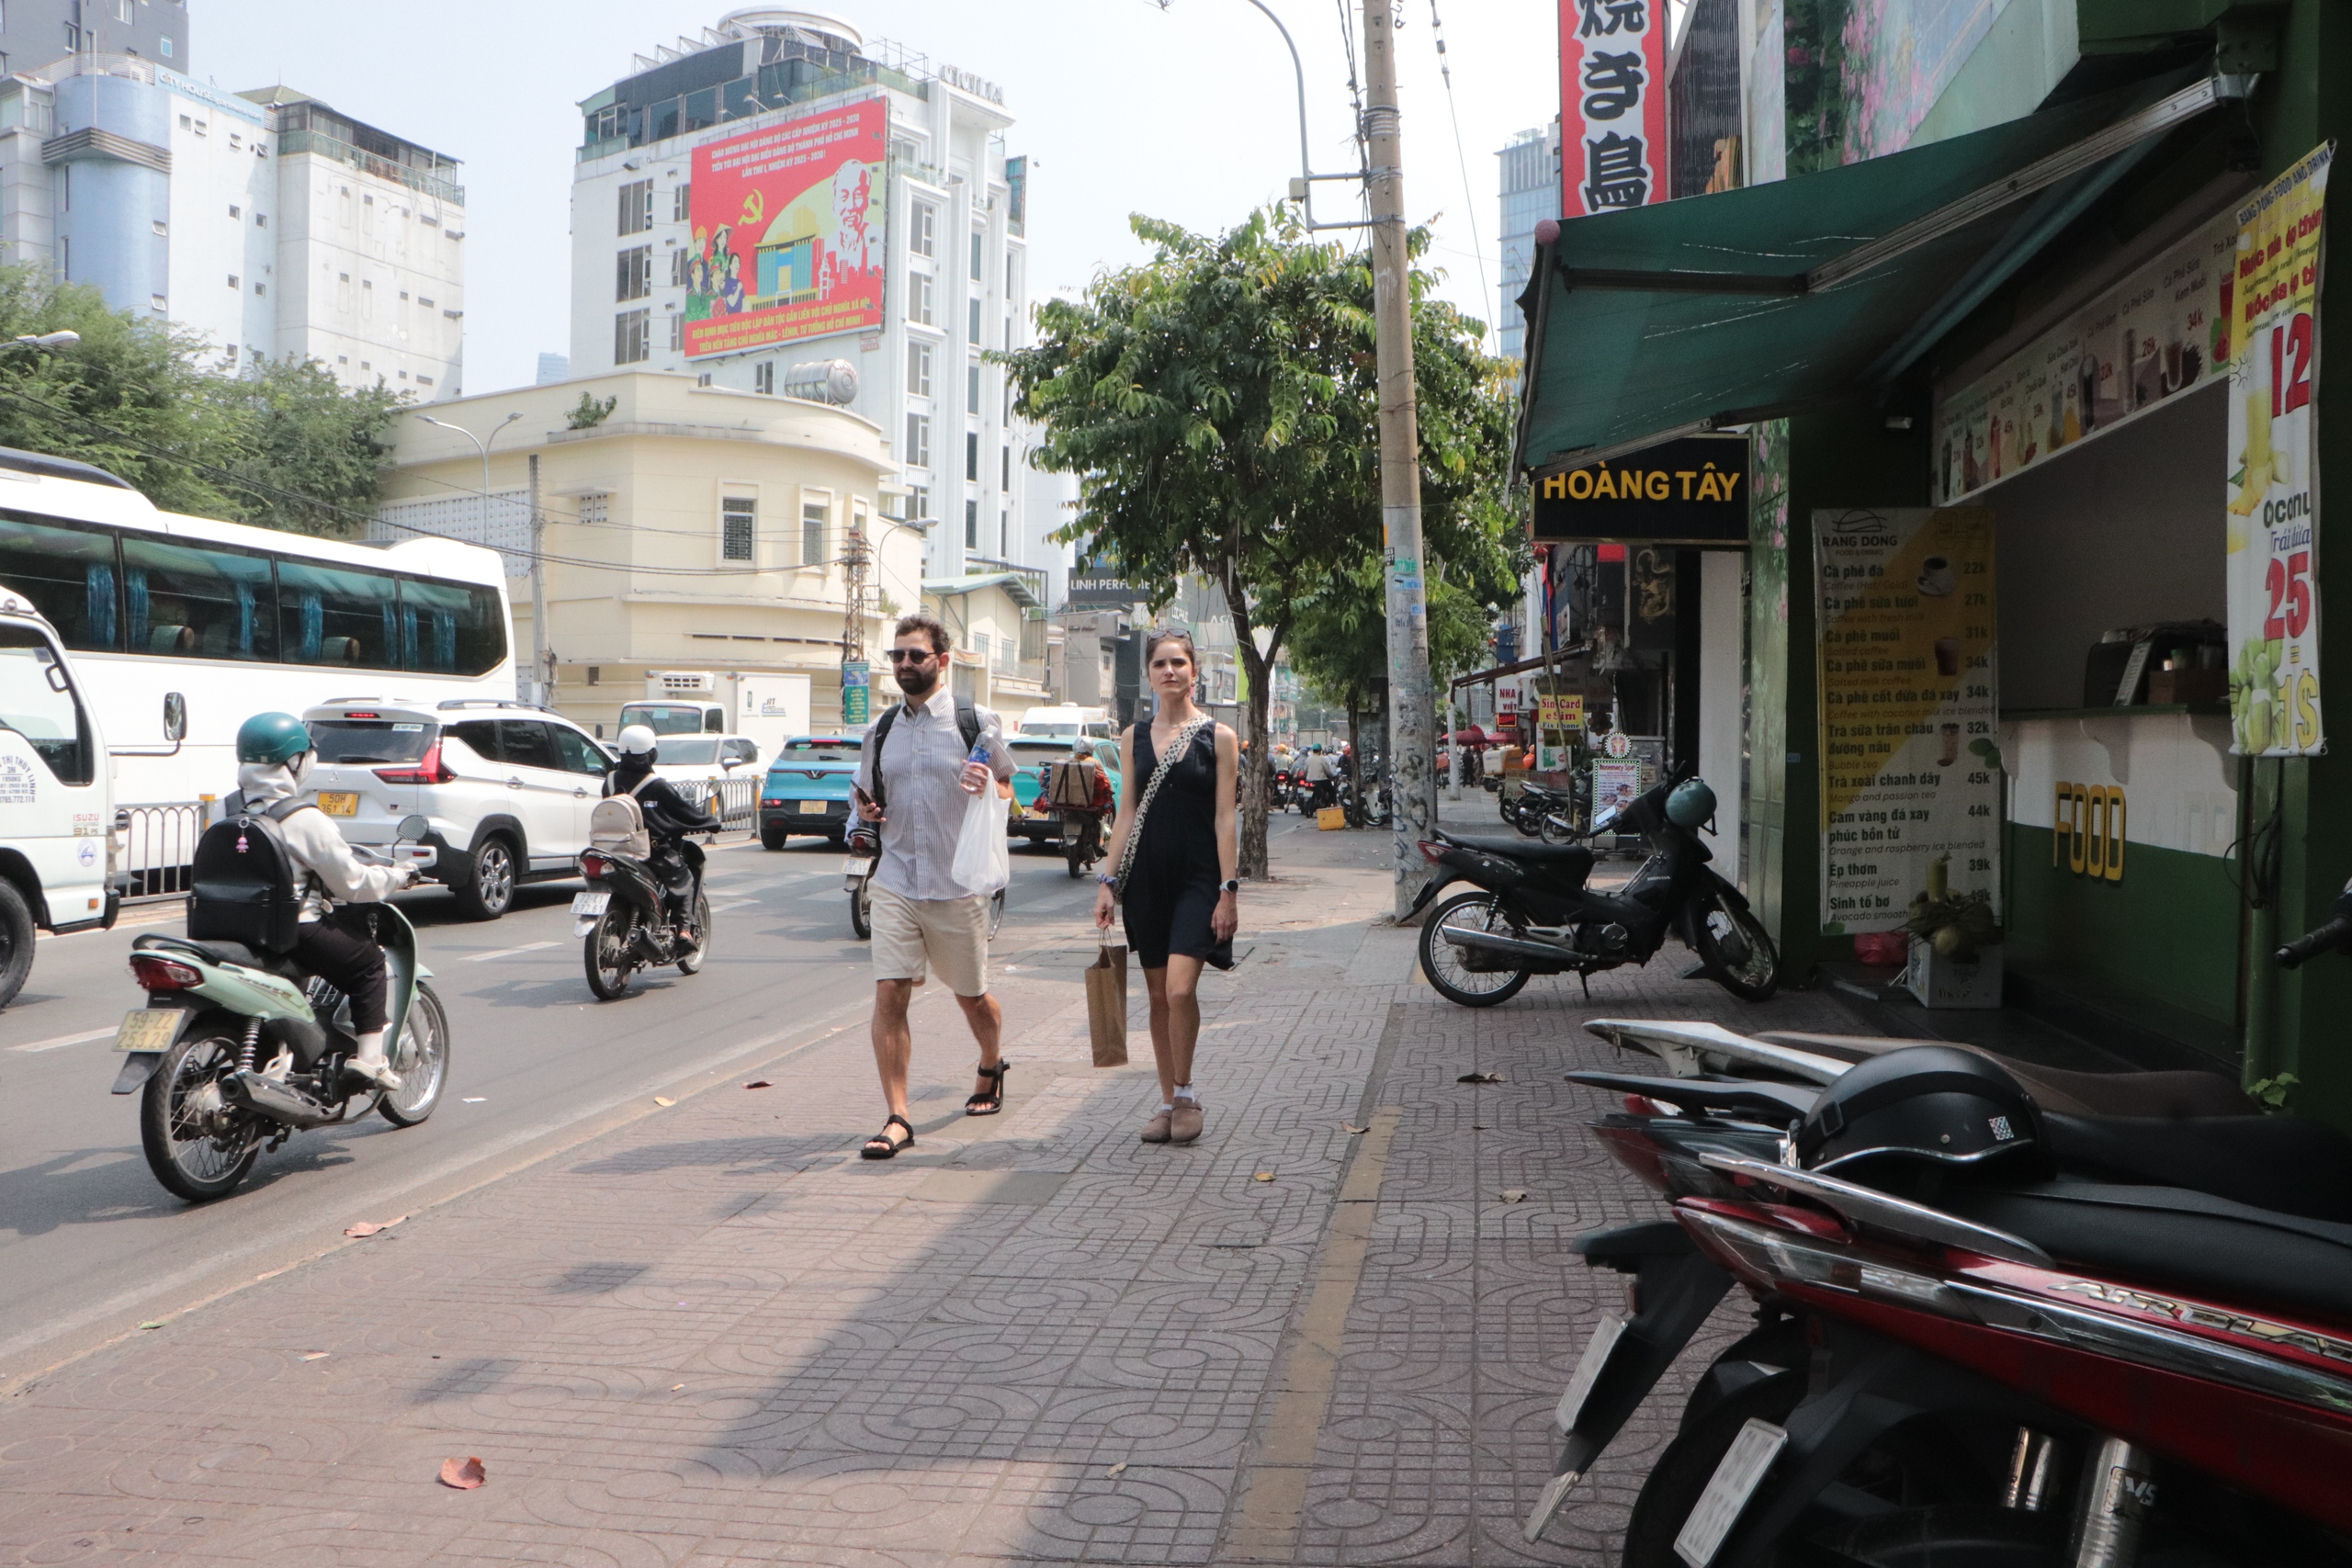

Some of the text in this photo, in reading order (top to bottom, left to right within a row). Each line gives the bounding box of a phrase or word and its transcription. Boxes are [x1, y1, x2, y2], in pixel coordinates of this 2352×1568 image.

[181, 80, 213, 102] HOUSE
[846, 113, 860, 124] 2030
[2188, 308, 2203, 331] 34k
[1544, 461, 1741, 502] HOÀNG TÂY
[1822, 535, 1898, 547] RANG DONG
[1824, 564, 1883, 580] Cà phê đá
[1963, 562, 1986, 574] 22k
[1070, 579, 1097, 590] LINH
[1825, 581, 1854, 591] Coffee
[1825, 597, 1840, 610] Cà
[1844, 596, 1865, 612] phê
[1869, 596, 1892, 608] sữa
[1964, 594, 1986, 606] 27k
[1826, 614, 1926, 624] Coffee with fresh milk
[1826, 627, 1900, 645] Cà phê muối
[1965, 626, 1987, 638] 31k
[1827, 646, 1889, 656] Salted coffee
[1826, 656, 1926, 674] Cà phê sữa muối
[1965, 656, 1988, 668] 34k
[1828, 676, 1911, 686] Salted milk coffee
[1827, 689, 1960, 705] Cà phê cốt dừa đá xay
[1967, 685, 1989, 698] 34k
[1560, 699, 1580, 709] Card
[1554, 711, 1576, 720] Sim
[1827, 705, 1996, 719] Coffee with coconut milk ice blended
[1828, 722, 1934, 737] Trà sữa trân châu
[1967, 722, 1989, 734] 32k
[1828, 740, 1891, 756] đường nâu
[1828, 761, 1860, 769] Bubble
[1828, 773, 1940, 787] Trà xoài chanh dây
[1967, 773, 1990, 784] 45k
[1829, 791, 1936, 803] Mango and passion tea
[1829, 808, 1929, 824] Cam vàng đá xay
[1968, 805, 1990, 818] 44k
[1829, 829, 1859, 845] phúc
[1861, 826, 1883, 841] bồn
[2053, 781, 2126, 882] FOOD
[1829, 840, 1985, 856] Orange and raspberry ice blended
[1829, 863, 1877, 878] Ép thơm
[1969, 858, 1990, 871] 39k
[1829, 878, 1900, 890] Pineapple juice
[1829, 894, 1890, 909] Sinh tố bơ
[1831, 910, 1909, 921] Avocado smooth
[2047, 1282, 2181, 1321] AIR
